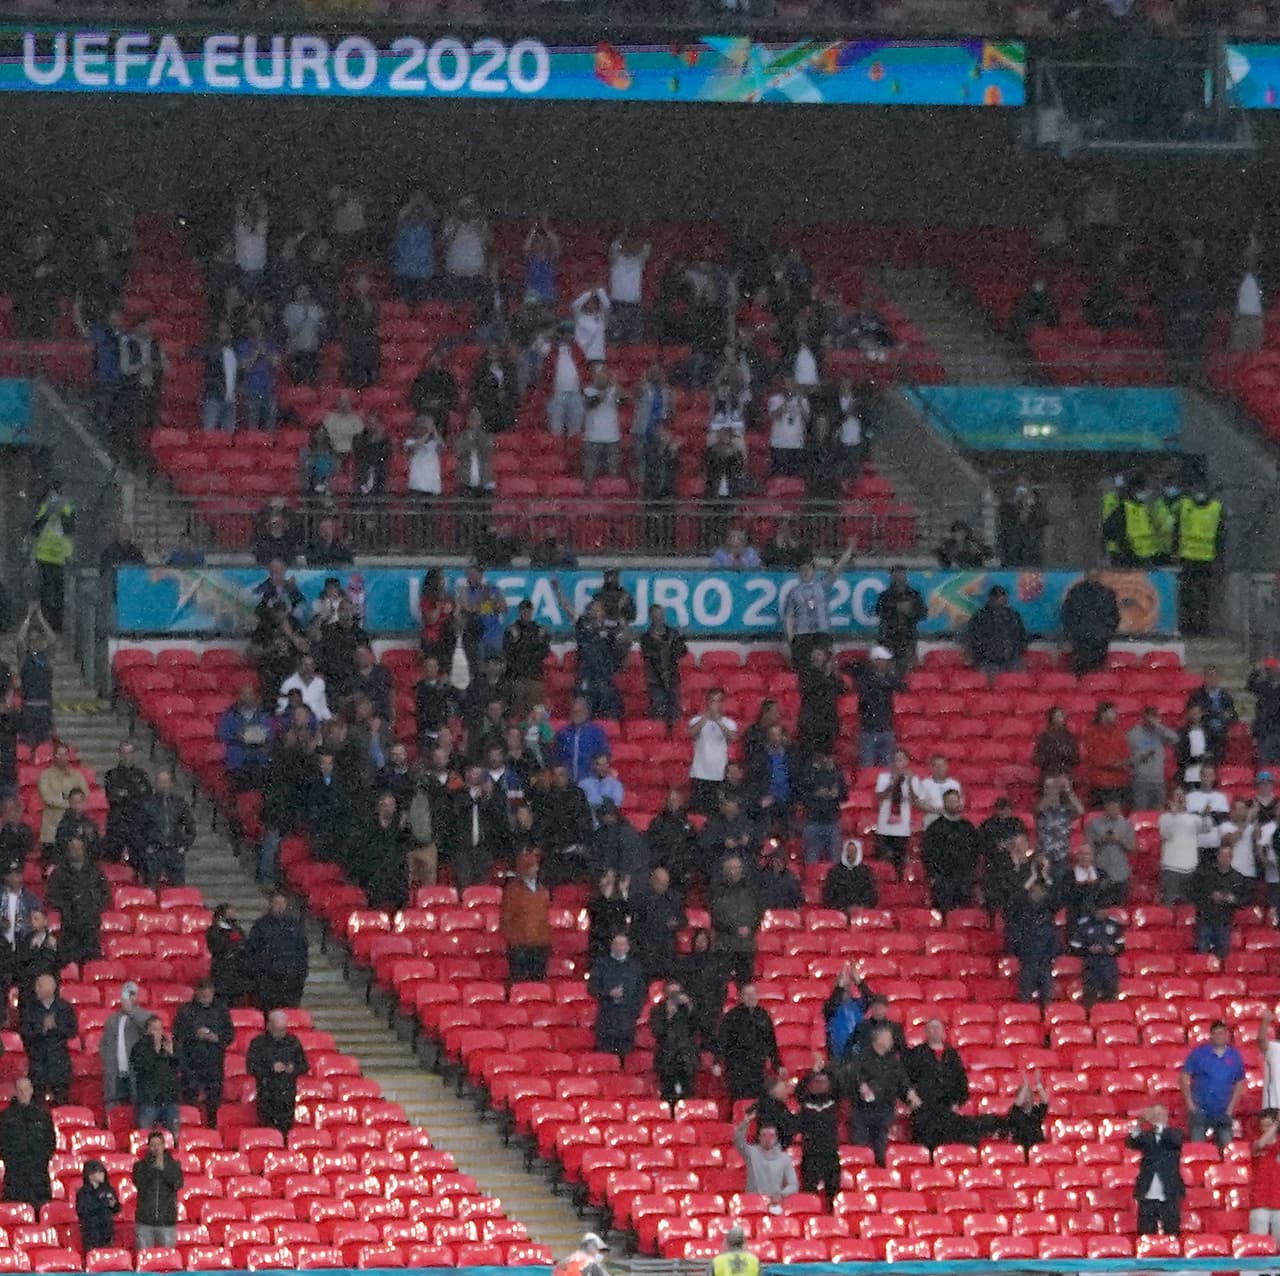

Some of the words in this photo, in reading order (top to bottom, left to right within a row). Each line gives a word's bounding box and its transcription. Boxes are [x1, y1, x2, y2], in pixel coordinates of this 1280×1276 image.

[22, 31, 192, 87] UEFA
[202, 35, 378, 91] EURO
[388, 38, 551, 93] 2020
